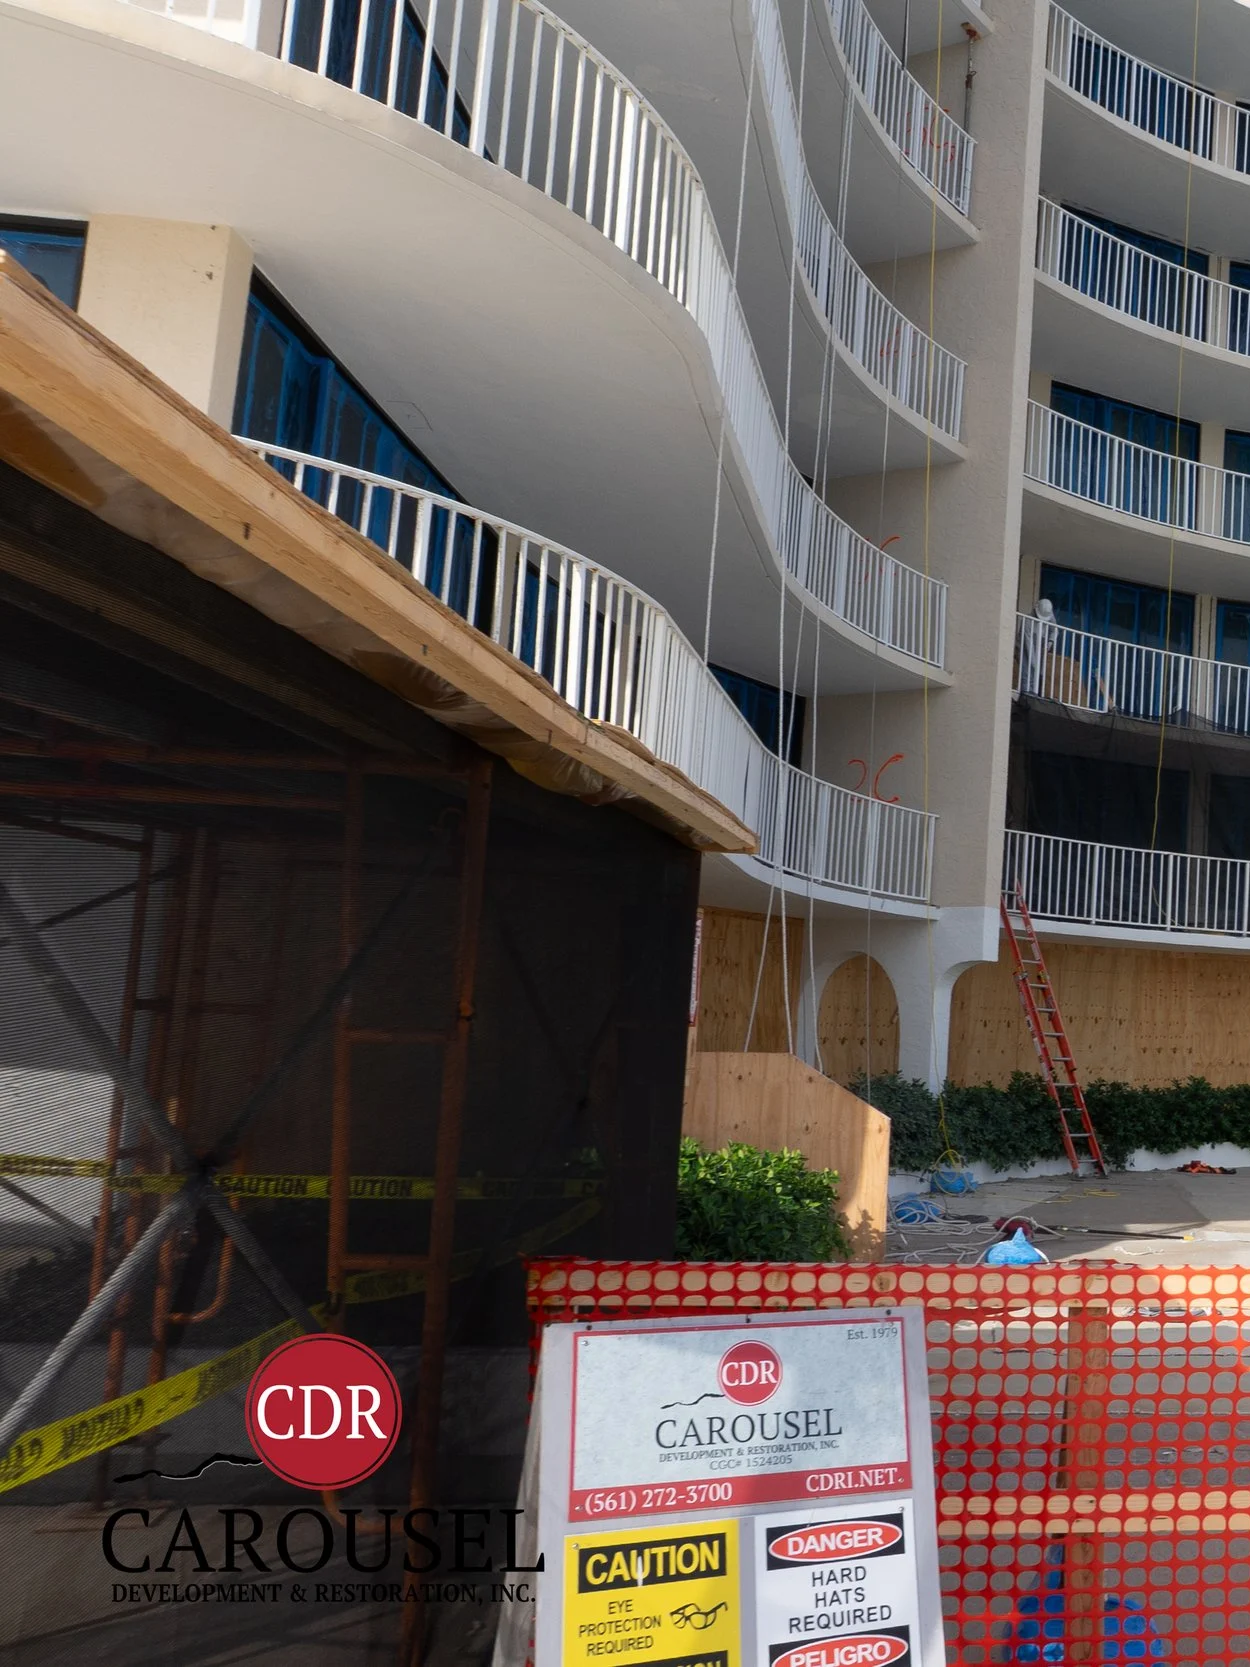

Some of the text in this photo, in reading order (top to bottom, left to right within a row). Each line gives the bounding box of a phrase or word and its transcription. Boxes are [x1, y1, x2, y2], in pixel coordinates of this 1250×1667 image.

[847, 1326, 898, 1341] Est. 1979
[721, 1360, 779, 1387] CDR
[655, 1408, 842, 1450] CAROUSEL
[659, 1440, 840, 1463] DEVELOPMENT & RESTORATION, INC.
[709, 1454, 793, 1471] CGC# 1524205
[806, 1467, 898, 1493] CDRI.NET
[584, 1482, 733, 1516] (561) 272-3700
[787, 1528, 884, 1557] DANGER
[585, 1541, 720, 1586] CAUTION
[812, 1565, 867, 1586] HARD
[608, 1599, 634, 1615] EYE
[815, 1587, 865, 1608] HATS
[578, 1615, 662, 1637] PROTECTION
[789, 1605, 892, 1634] REQUIRED
[586, 1635, 655, 1657] REQUIRED
[790, 1641, 891, 1667] PELIGRO
